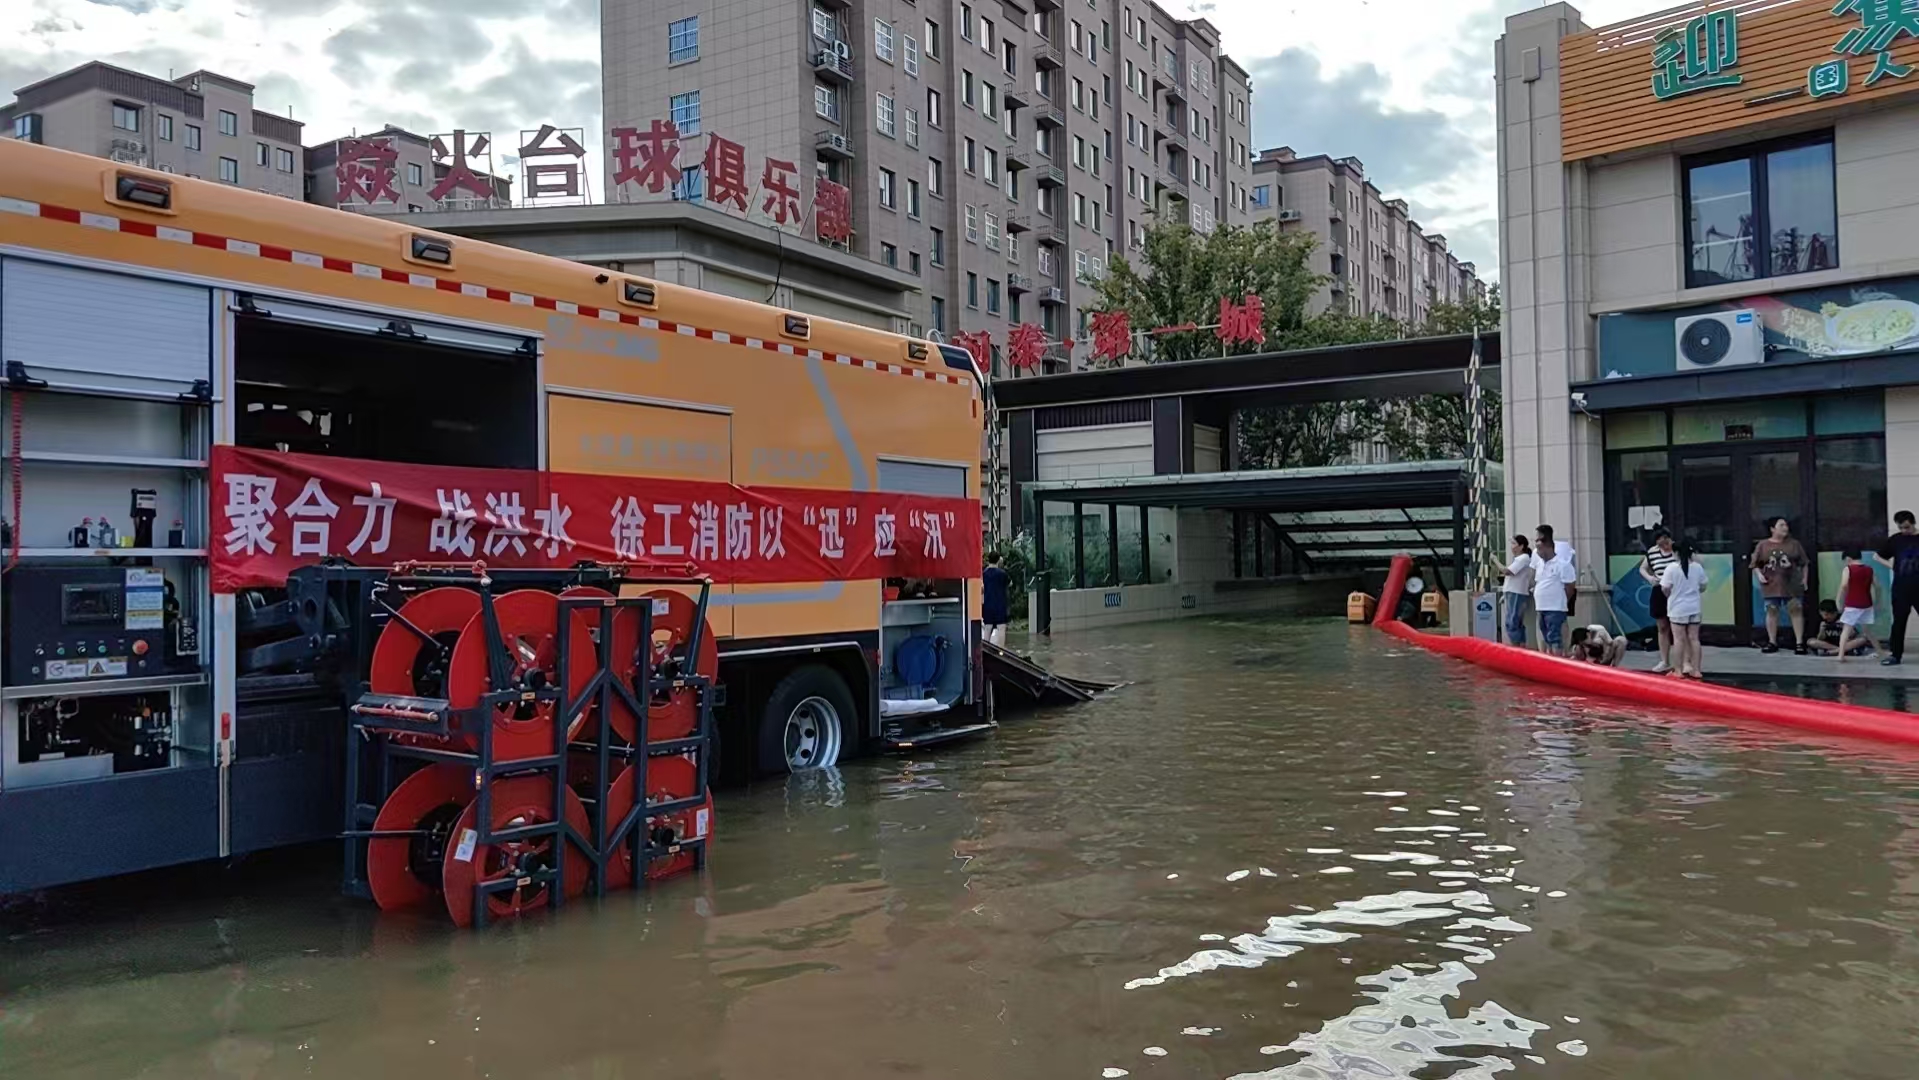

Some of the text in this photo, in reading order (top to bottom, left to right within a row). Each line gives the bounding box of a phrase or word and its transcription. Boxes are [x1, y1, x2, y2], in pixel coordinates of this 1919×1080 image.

[223, 473, 398, 557] 聚合力
[429, 488, 577, 558] 战洪水
